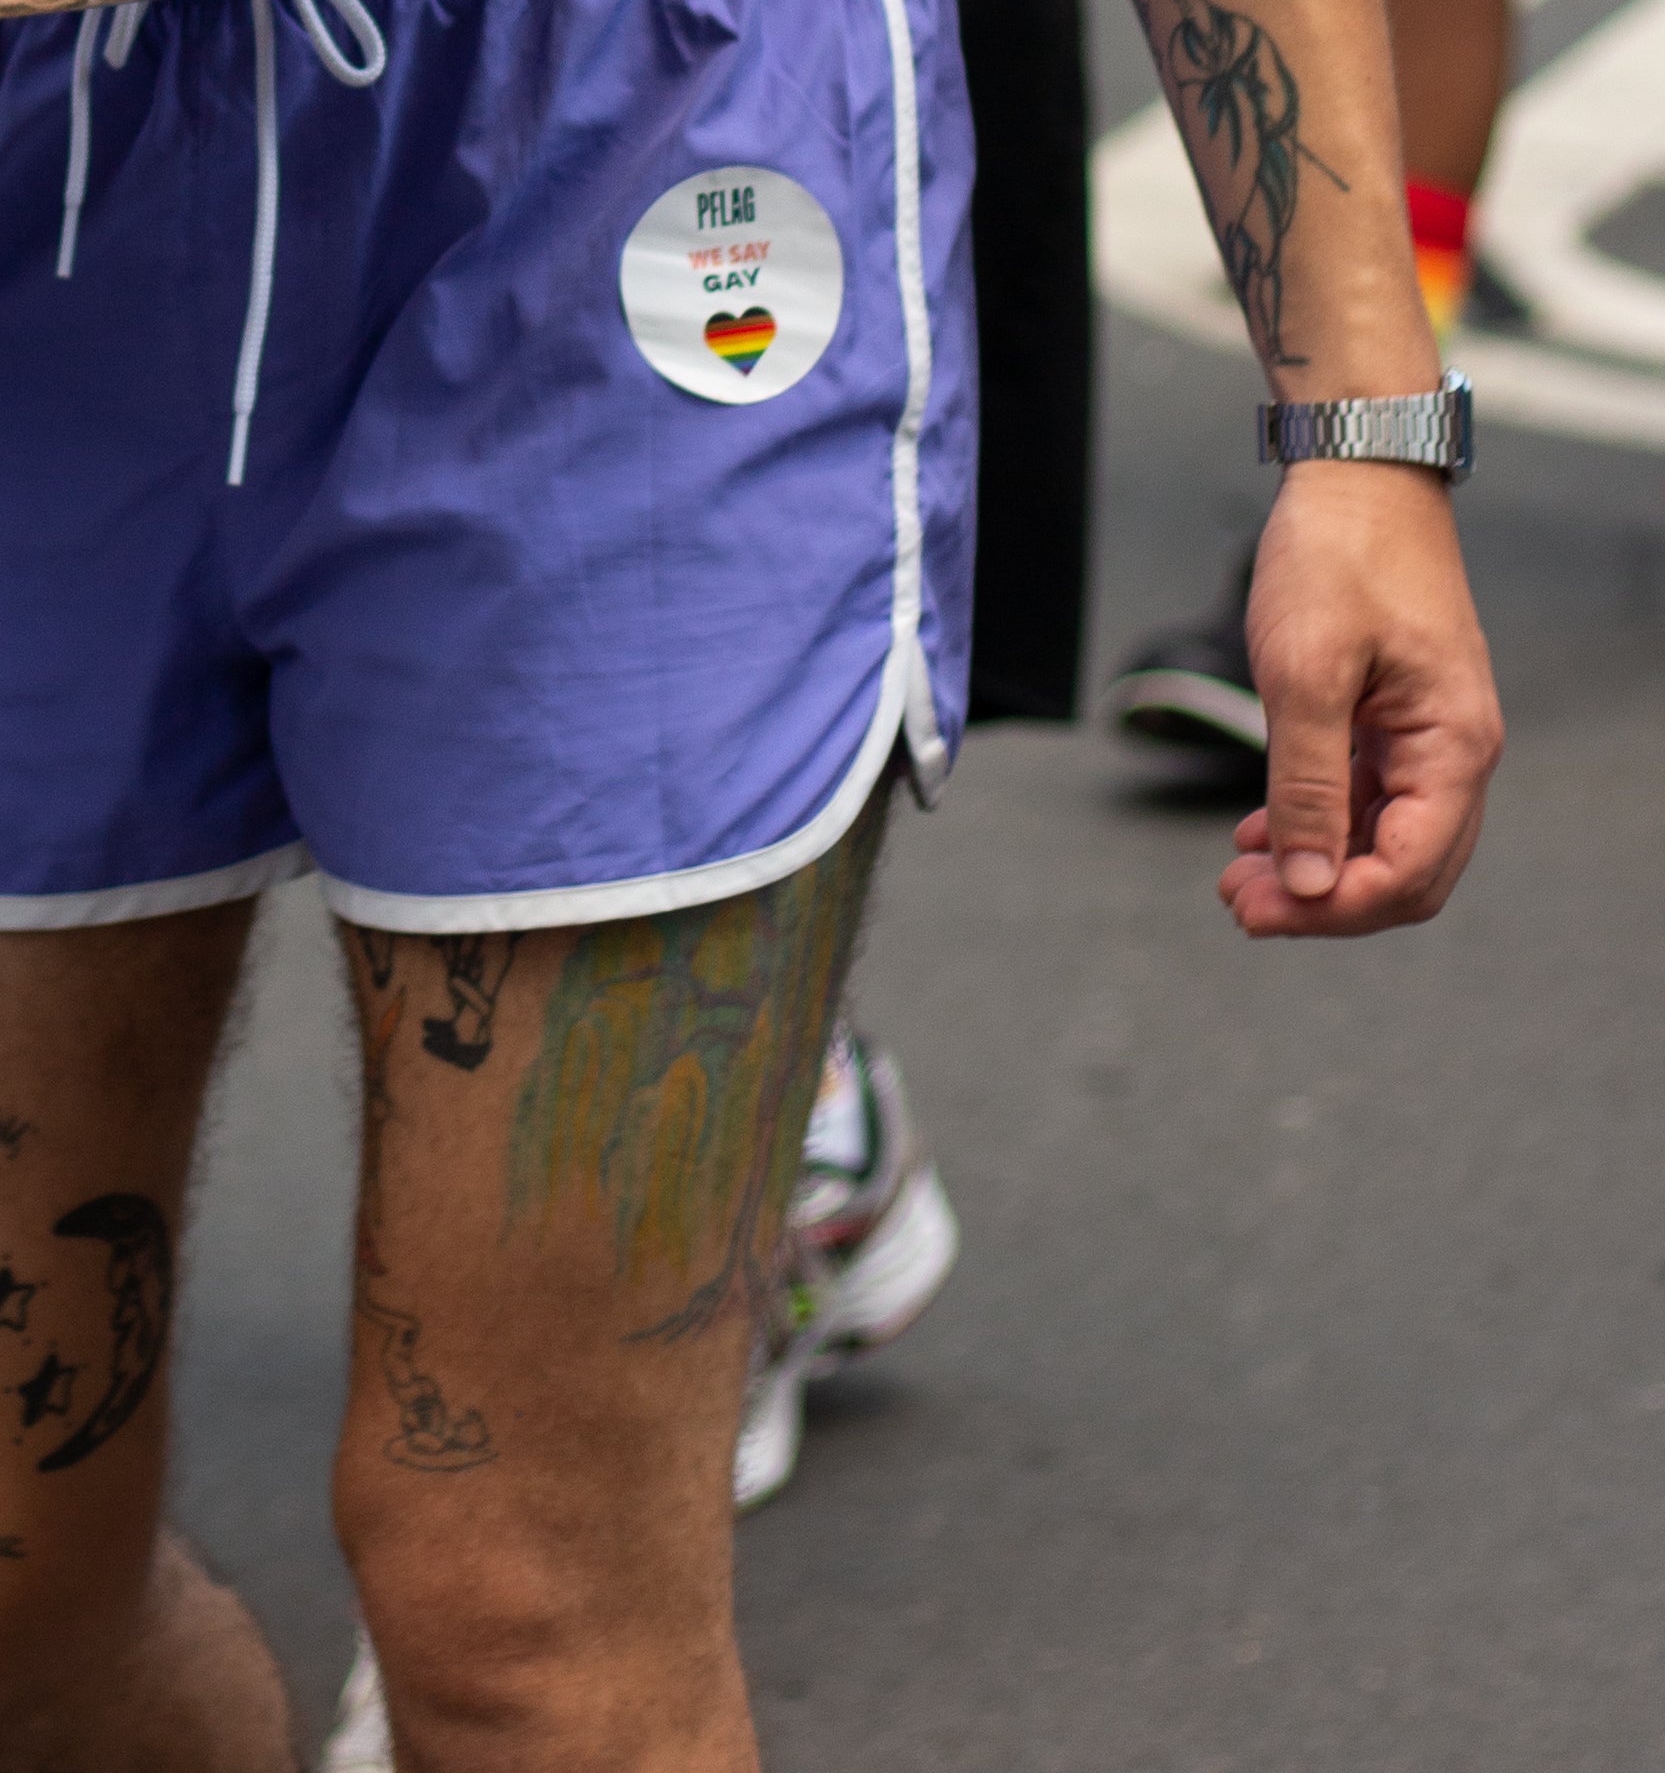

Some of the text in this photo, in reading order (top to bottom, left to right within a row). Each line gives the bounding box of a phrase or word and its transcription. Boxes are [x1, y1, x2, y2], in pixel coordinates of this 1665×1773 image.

[697, 186, 756, 231] PFLAG
[688, 239, 771, 269] WE SAY
[702, 267, 761, 293] GAY
